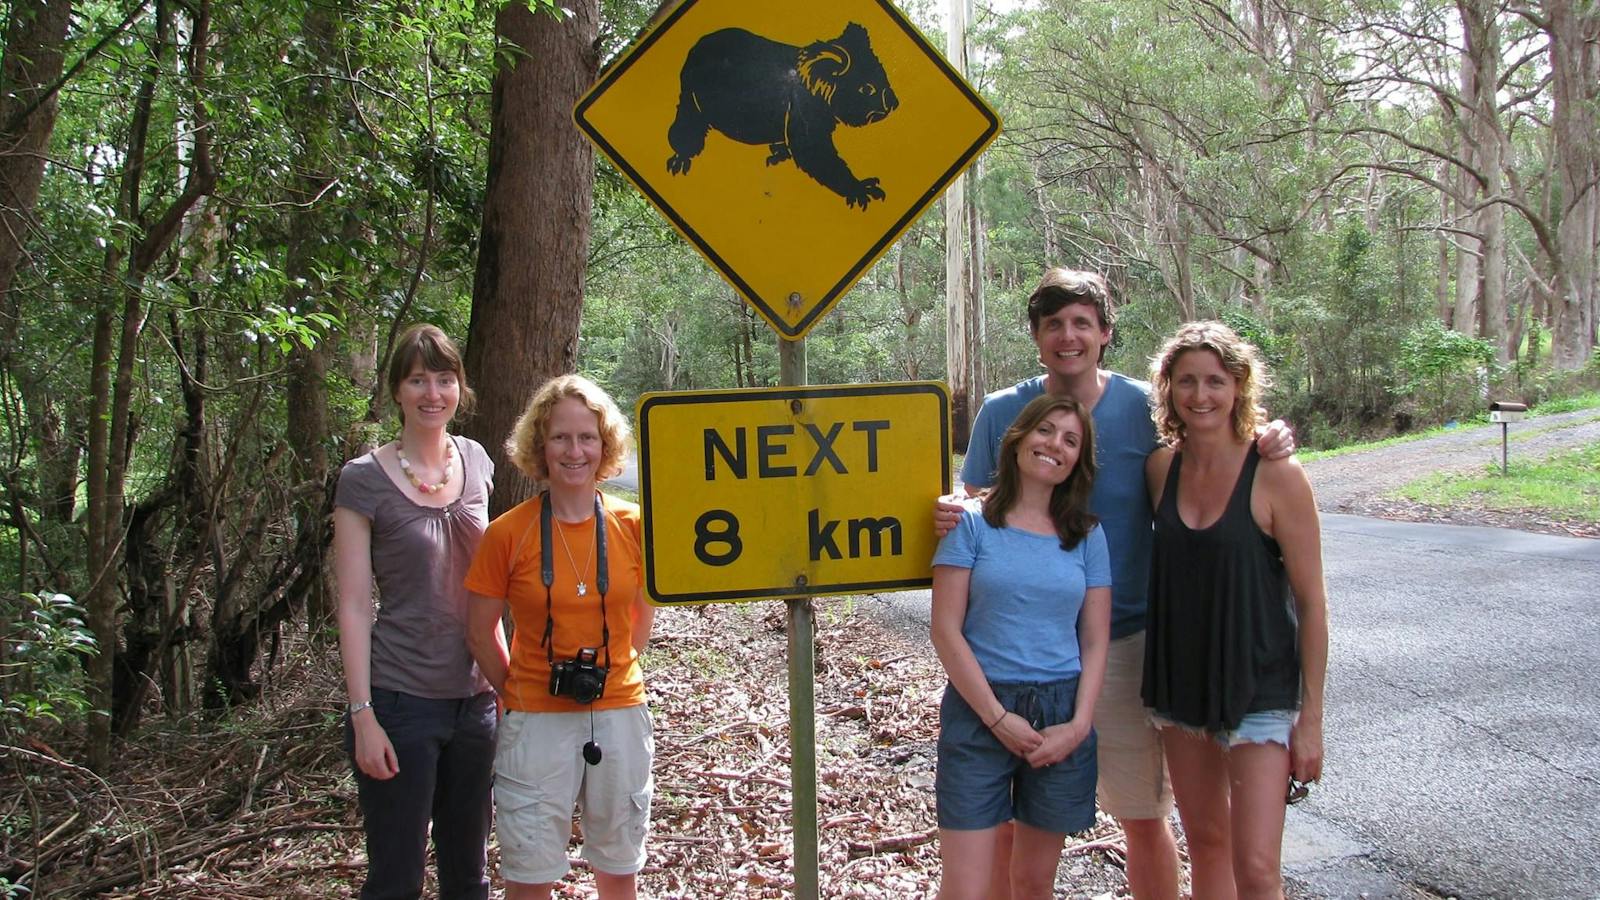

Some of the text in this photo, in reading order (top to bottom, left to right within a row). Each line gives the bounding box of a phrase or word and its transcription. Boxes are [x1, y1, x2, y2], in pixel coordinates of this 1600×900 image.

[703, 420, 890, 481] NEXT
[694, 508, 903, 566] 8 km
